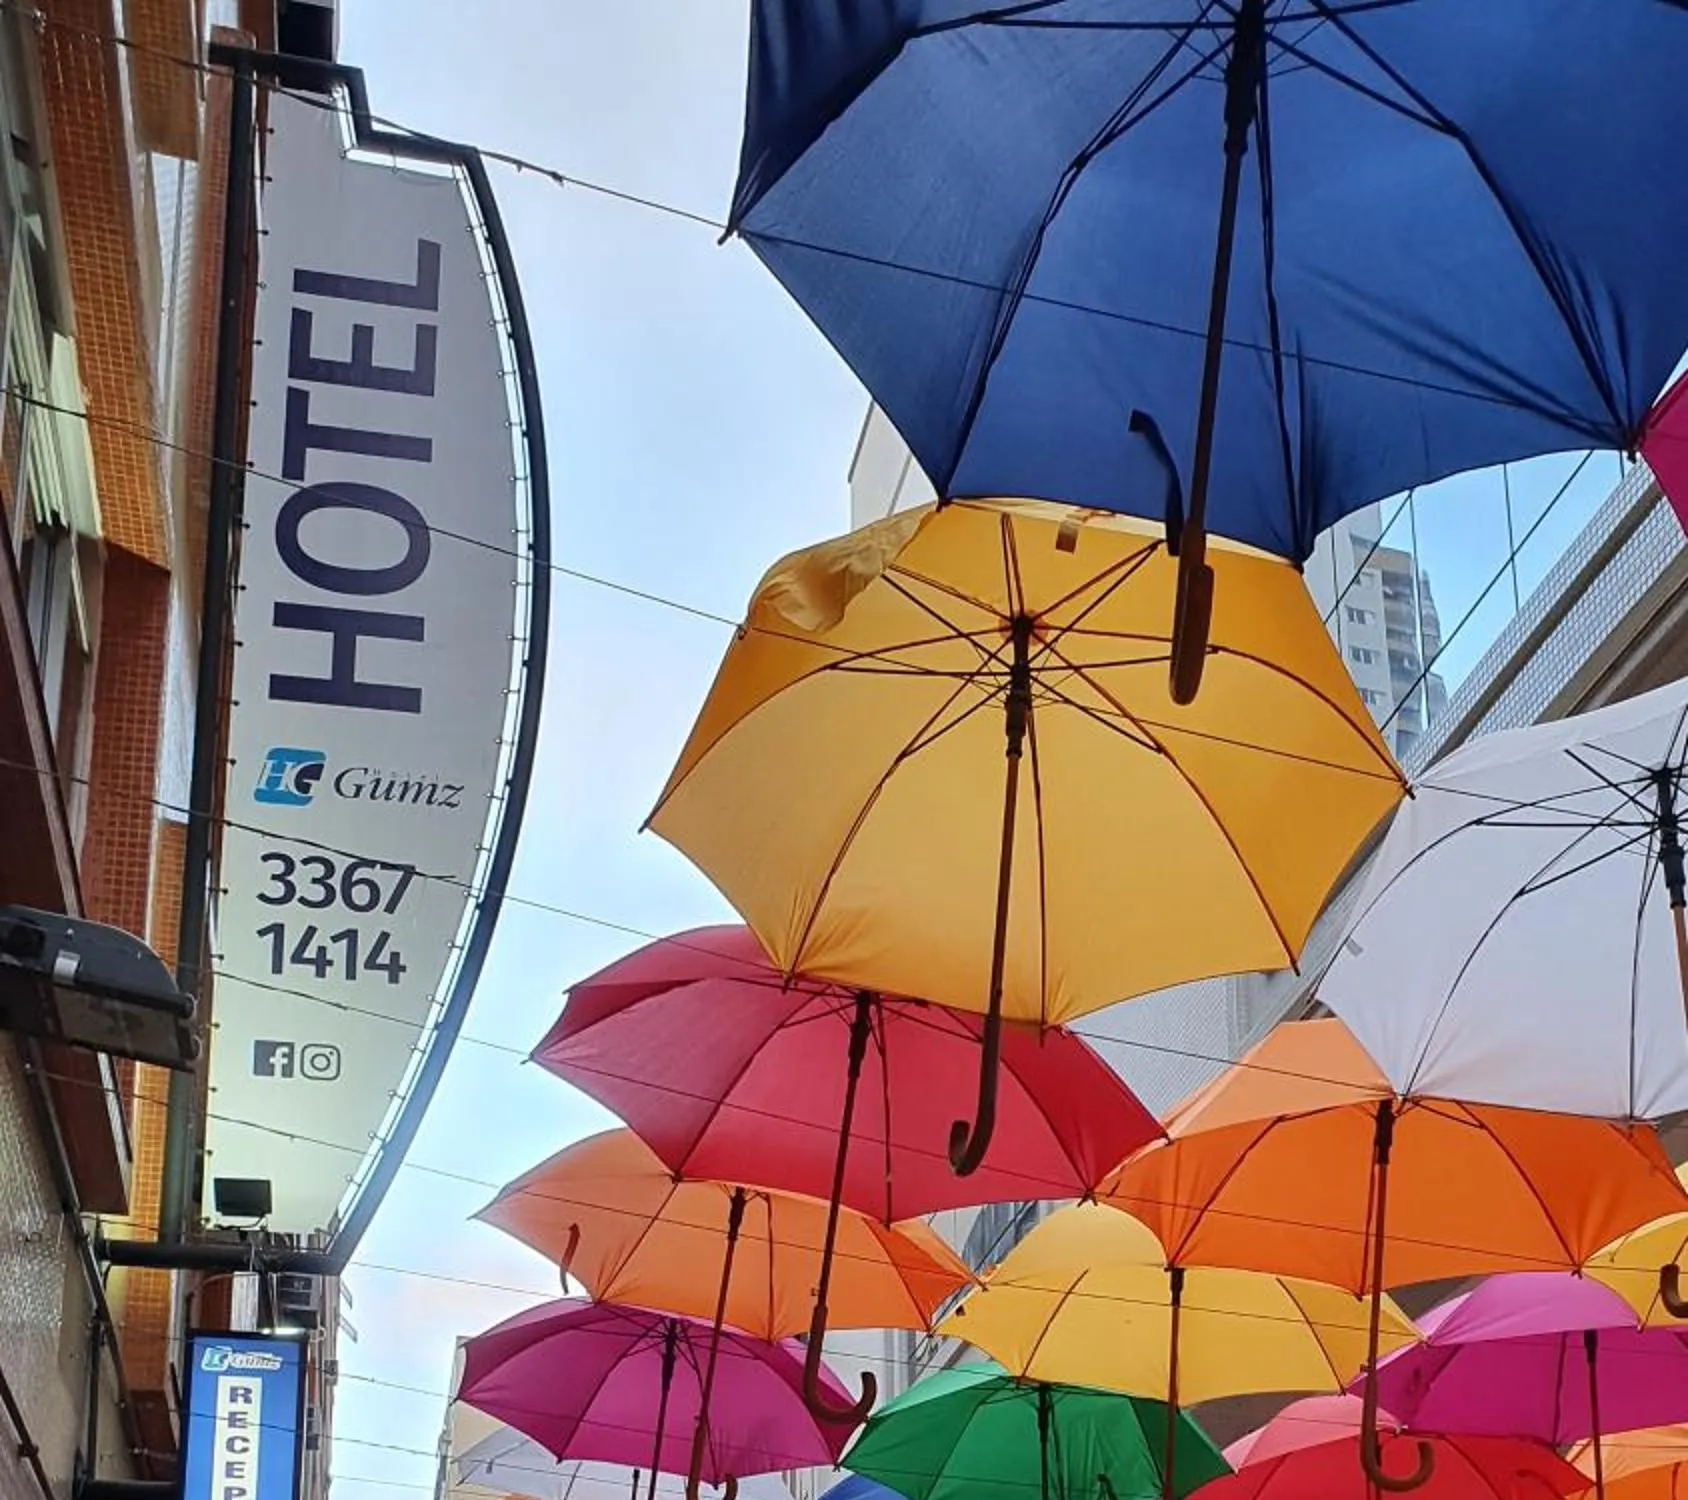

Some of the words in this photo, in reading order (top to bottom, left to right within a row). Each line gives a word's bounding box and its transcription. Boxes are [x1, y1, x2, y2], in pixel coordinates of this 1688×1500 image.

[268, 238, 441, 714] HOTEL
[256, 852, 416, 915] 3367
[256, 923, 407, 984] 1414
